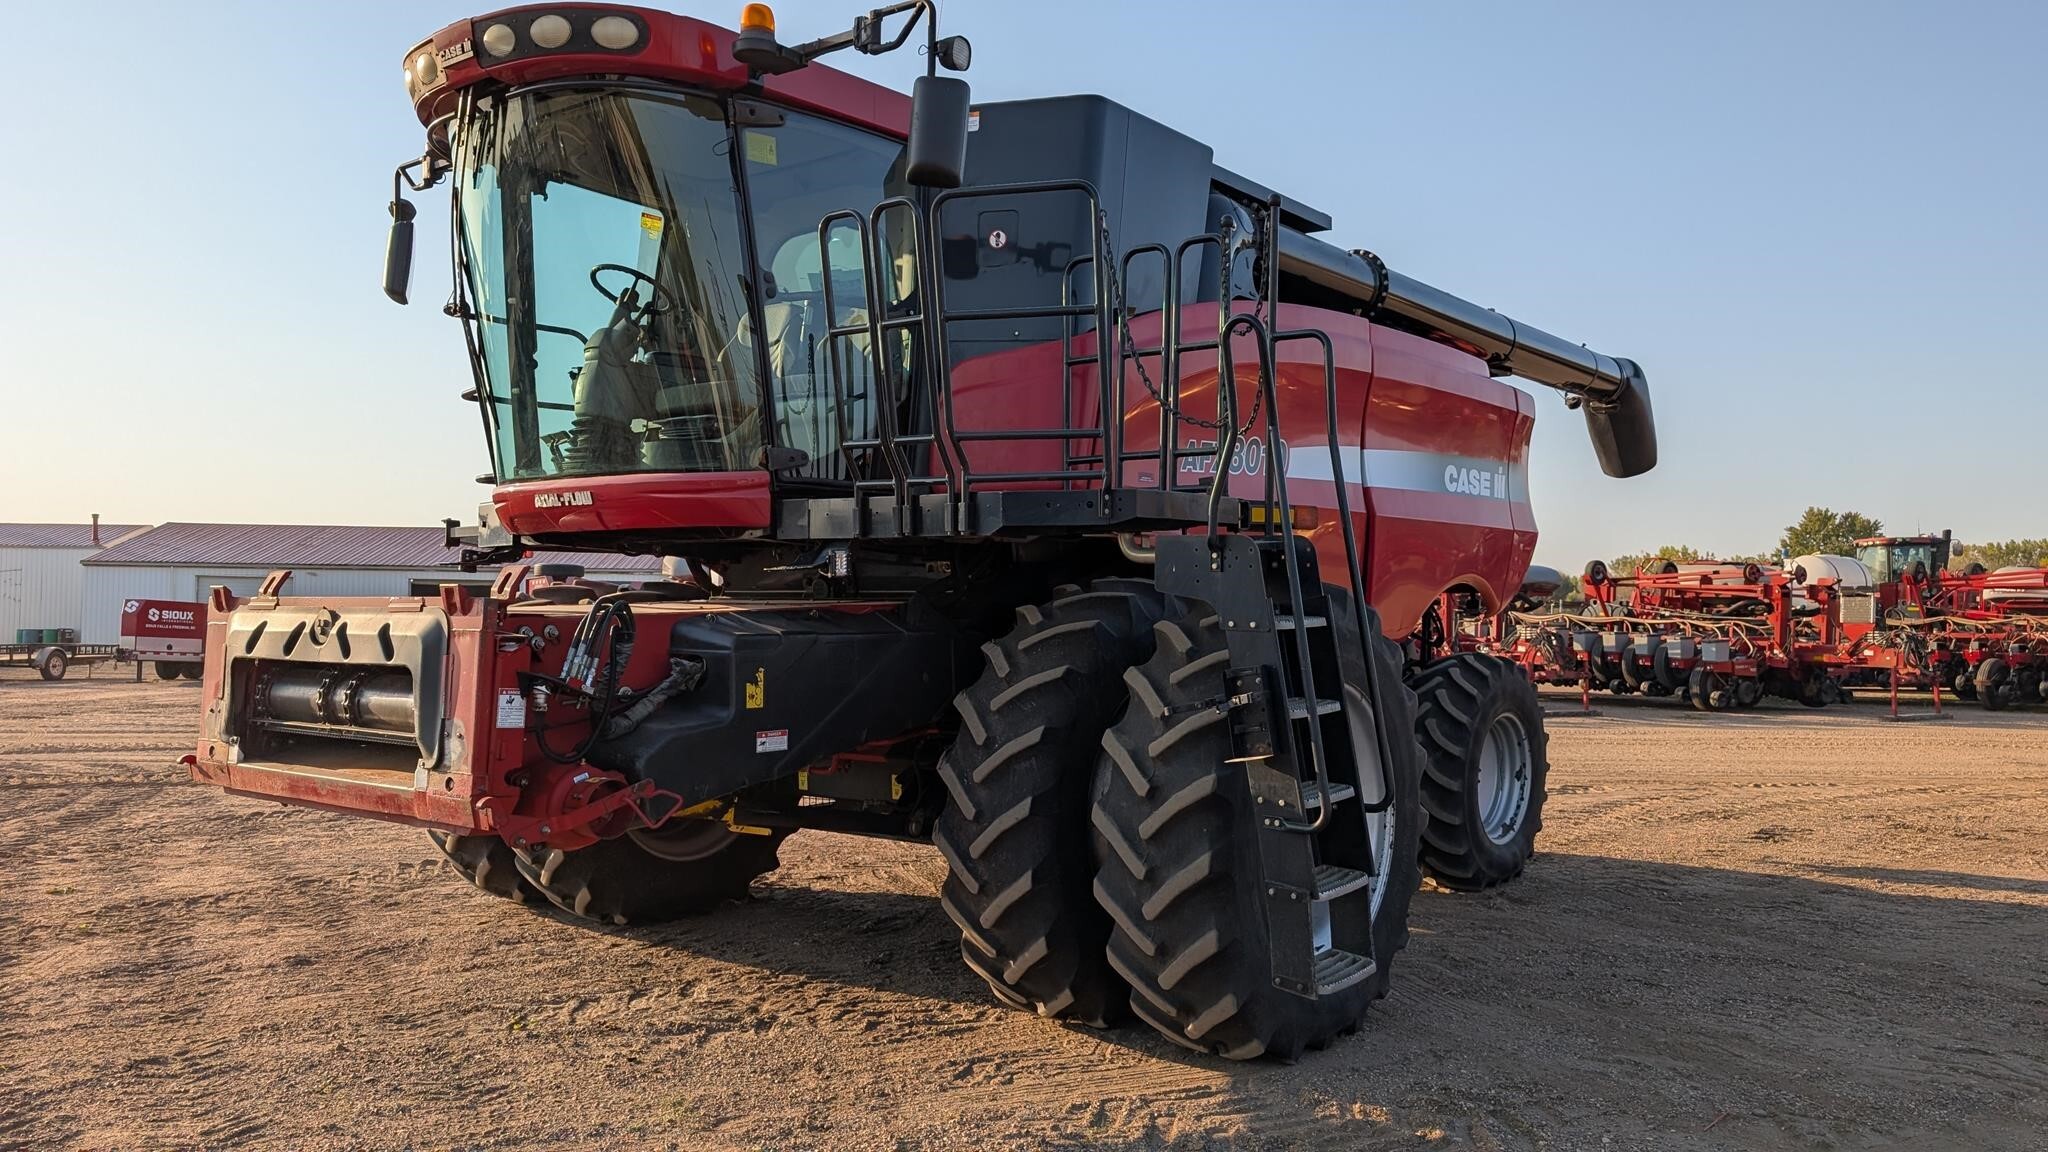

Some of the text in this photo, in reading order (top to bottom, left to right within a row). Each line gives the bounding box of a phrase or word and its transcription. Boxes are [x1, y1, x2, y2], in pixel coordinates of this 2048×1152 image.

[439, 43, 463, 62] CASE
[1444, 464, 1491, 497] CASE
[161, 610, 194, 621] SIOUX
